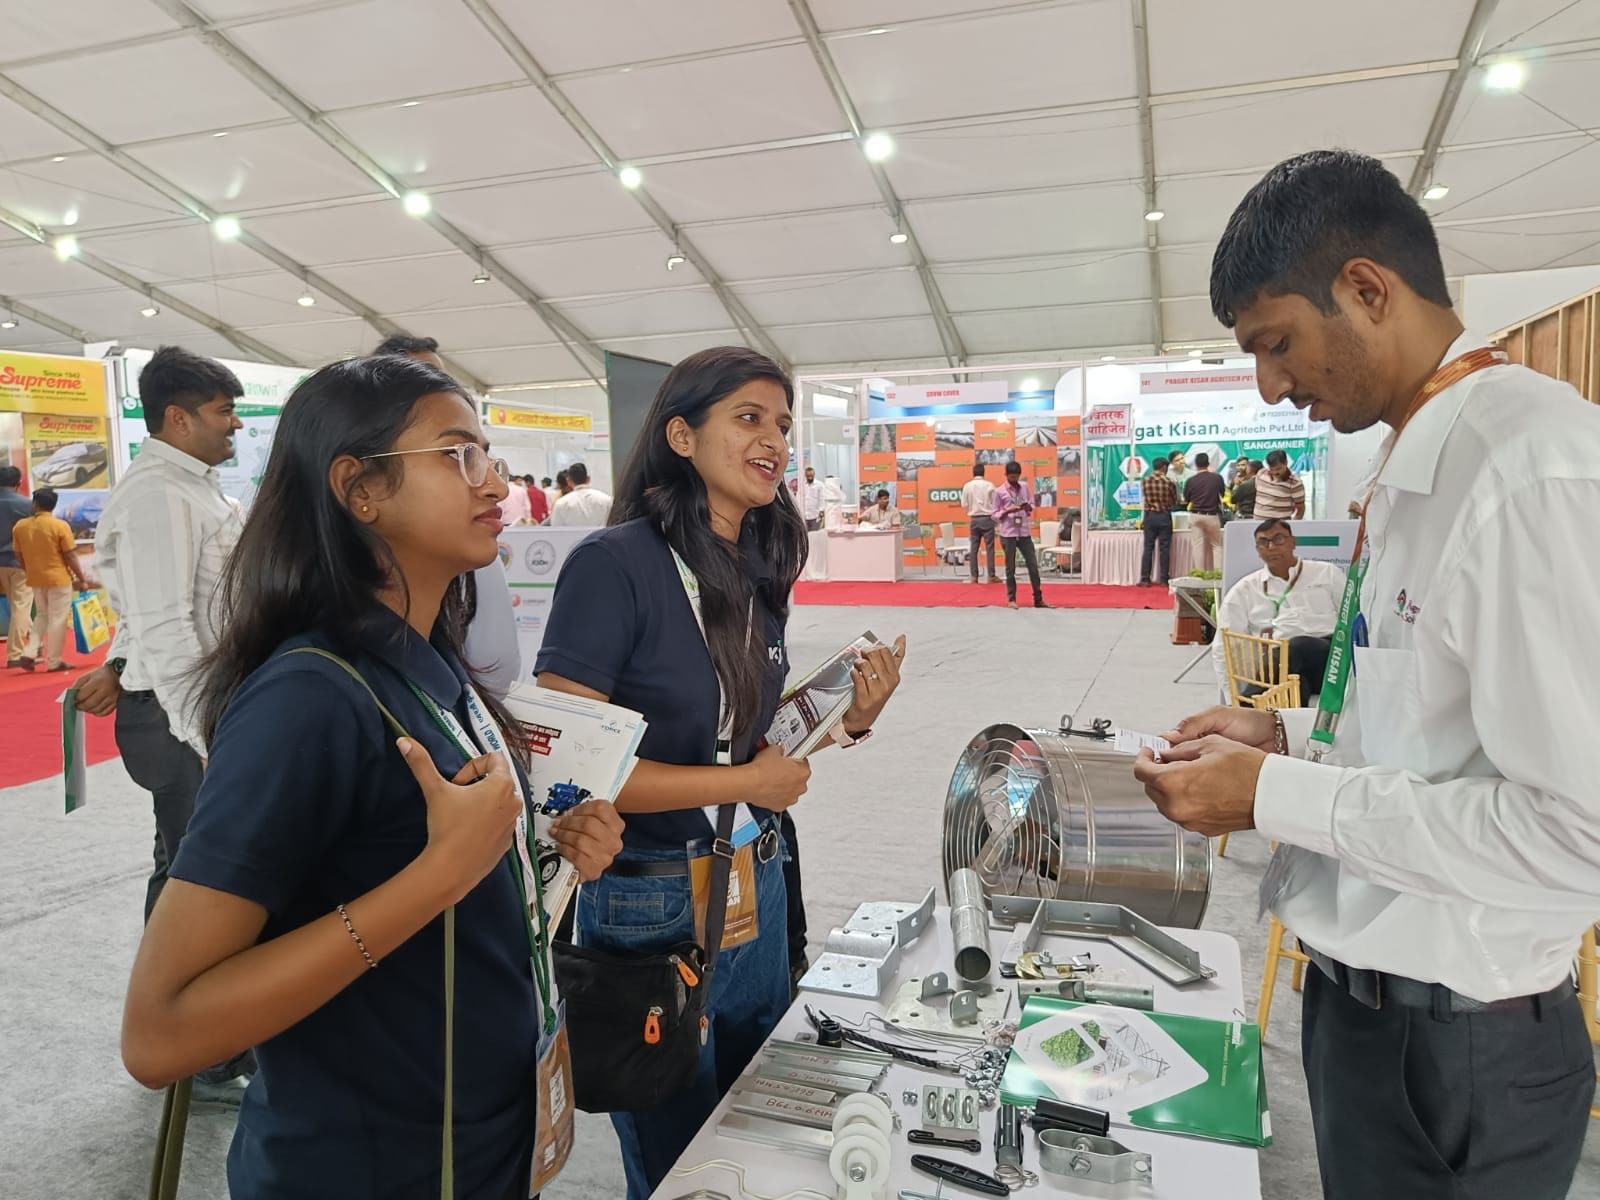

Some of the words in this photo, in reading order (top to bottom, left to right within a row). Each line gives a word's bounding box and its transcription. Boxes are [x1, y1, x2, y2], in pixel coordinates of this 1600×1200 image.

[0, 366, 81, 391] Supreme
[39, 416, 94, 432] Supreme
[1169, 422, 1219, 436] Kisan
[1222, 422, 1266, 436] Agritech
[1243, 440, 1305, 450] SANGAMNER
[1327, 646, 1343, 684] KISAN
